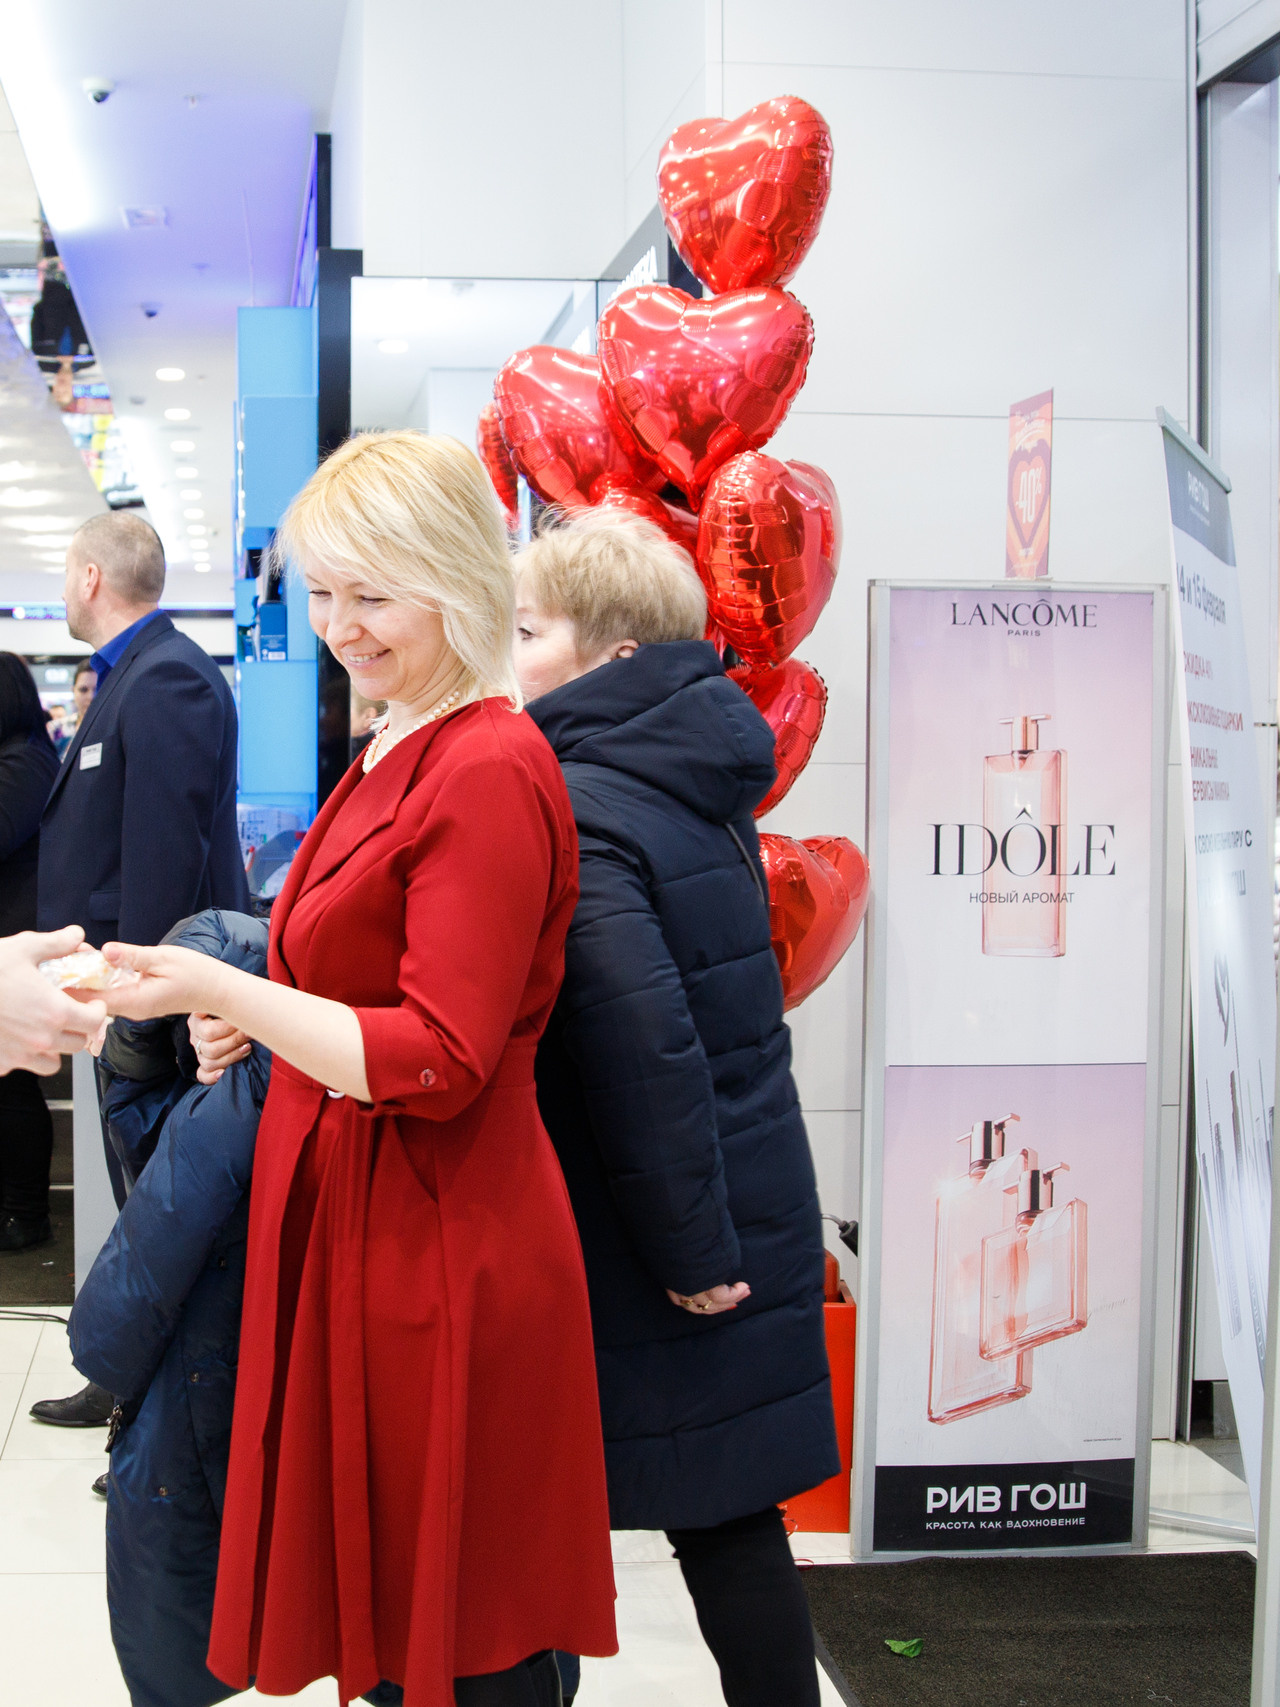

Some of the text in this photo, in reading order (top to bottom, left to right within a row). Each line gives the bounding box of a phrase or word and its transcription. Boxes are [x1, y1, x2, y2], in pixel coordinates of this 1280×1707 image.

[951, 598, 1098, 628] LANCÔME
[1007, 629, 1042, 637] PARIS
[926, 807, 1116, 877] IDÔLE
[969, 890, 1075, 904] НОВЫЙ АРОМАТ
[926, 1482, 1087, 1514] РИВ ГОШ
[925, 1517, 1086, 1530] КРАСОТА КАК ВДОХНОВЕНИЕ
